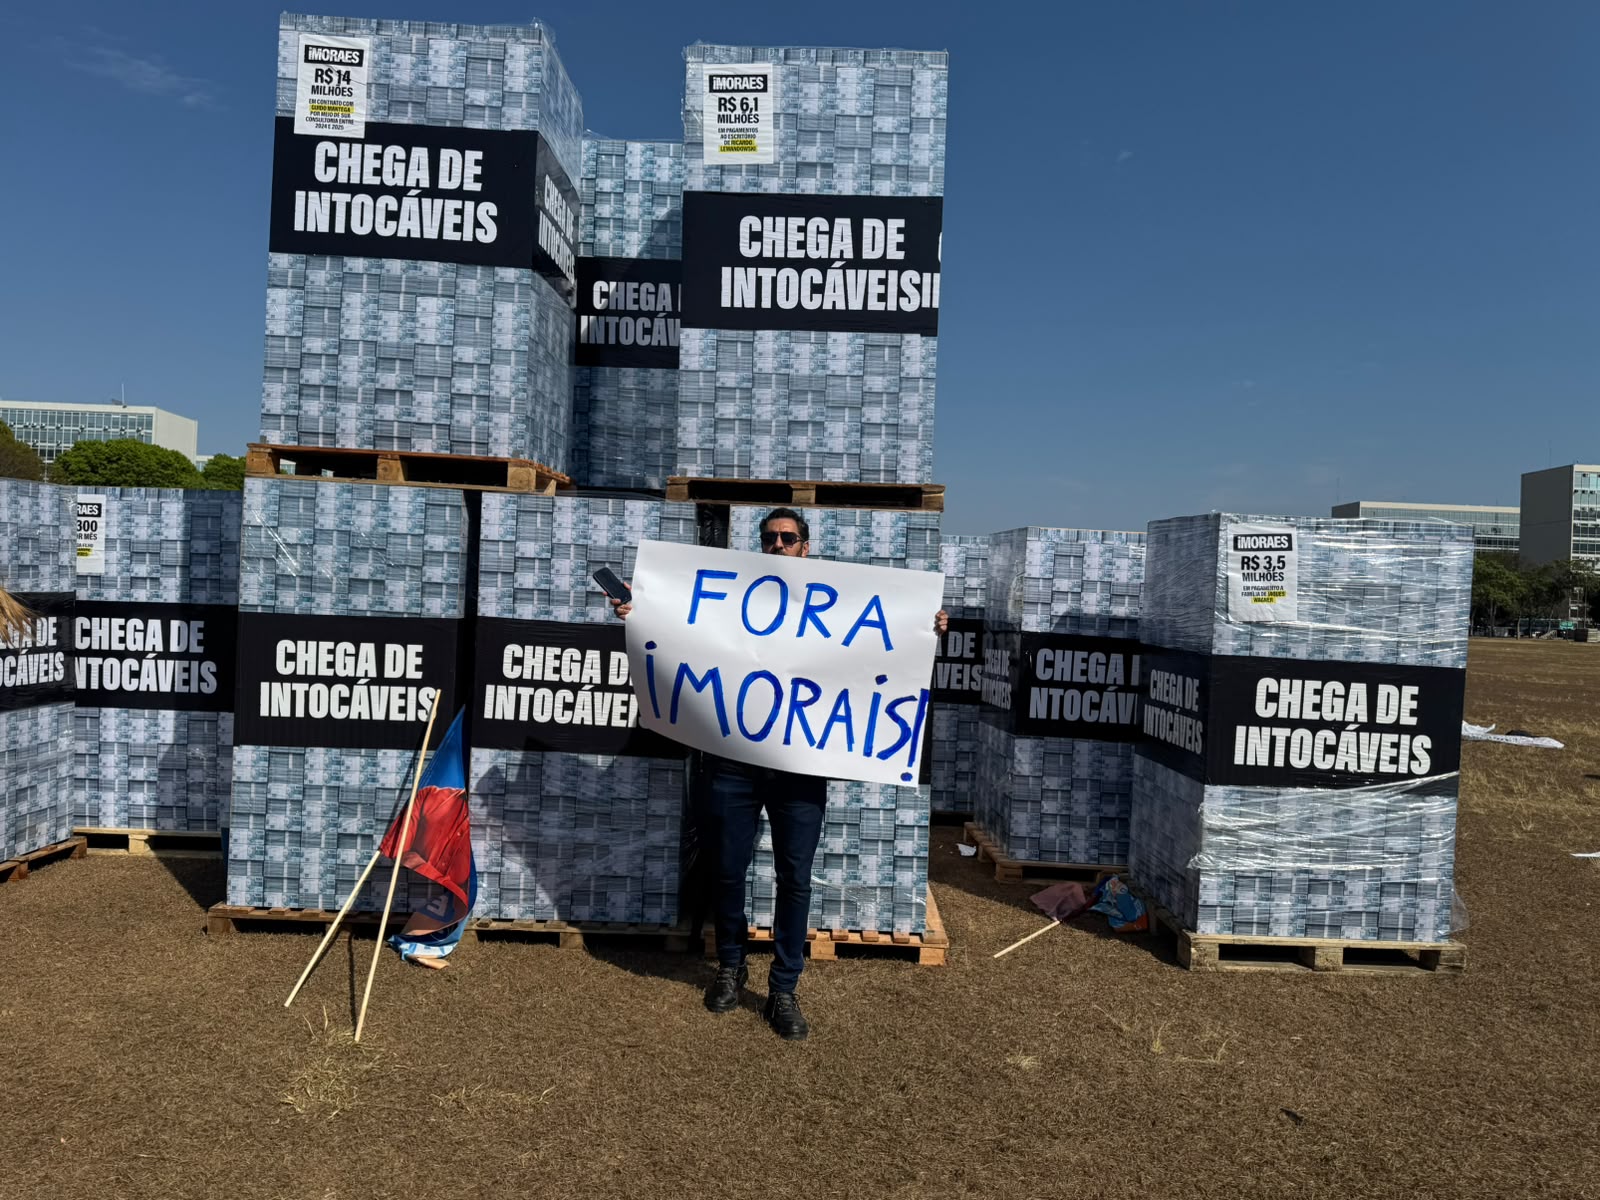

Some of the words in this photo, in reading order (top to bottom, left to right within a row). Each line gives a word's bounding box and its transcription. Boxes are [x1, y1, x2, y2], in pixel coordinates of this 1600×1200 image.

[311, 83, 353, 97] MILHÕES
[314, 67, 333, 85] R$
[336, 69, 351, 86] 14
[717, 111, 759, 124] MILHÕES
[718, 96, 737, 113] R$
[740, 96, 758, 114] 6,1
[314, 141, 430, 188] CHEGA
[438, 148, 483, 191] DE
[294, 189, 498, 243] INTOCÁVEIS
[739, 215, 854, 259] CHEGA
[862, 218, 906, 260] DE
[593, 280, 673, 312] CHEGA
[720, 260, 921, 312] INTOCÁVEIS
[1241, 555, 1260, 571] R$
[1263, 555, 1286, 571] 3,5
[1242, 569, 1284, 582] MILHÕES
[687, 569, 894, 651] FORA
[75, 616, 163, 652] CHEGA
[170, 619, 204, 653] DE
[947, 631, 976, 658] DE
[276, 639, 377, 678] CHEGA
[384, 643, 423, 679] DE
[503, 643, 601, 684] CHEGA
[933, 662, 983, 691] VEIS
[1036, 648, 1125, 686] CHEGA
[260, 678, 438, 722] INTOCÁVEIS
[1150, 669, 1183, 707] CHEGA
[1184, 676, 1199, 712] DE
[1255, 677, 1368, 723] CHEGA
[1376, 684, 1420, 726] DE
[1143, 704, 1203, 754] INTOCÁVEIS
[1234, 724, 1432, 775] INTOCÁVEIS
